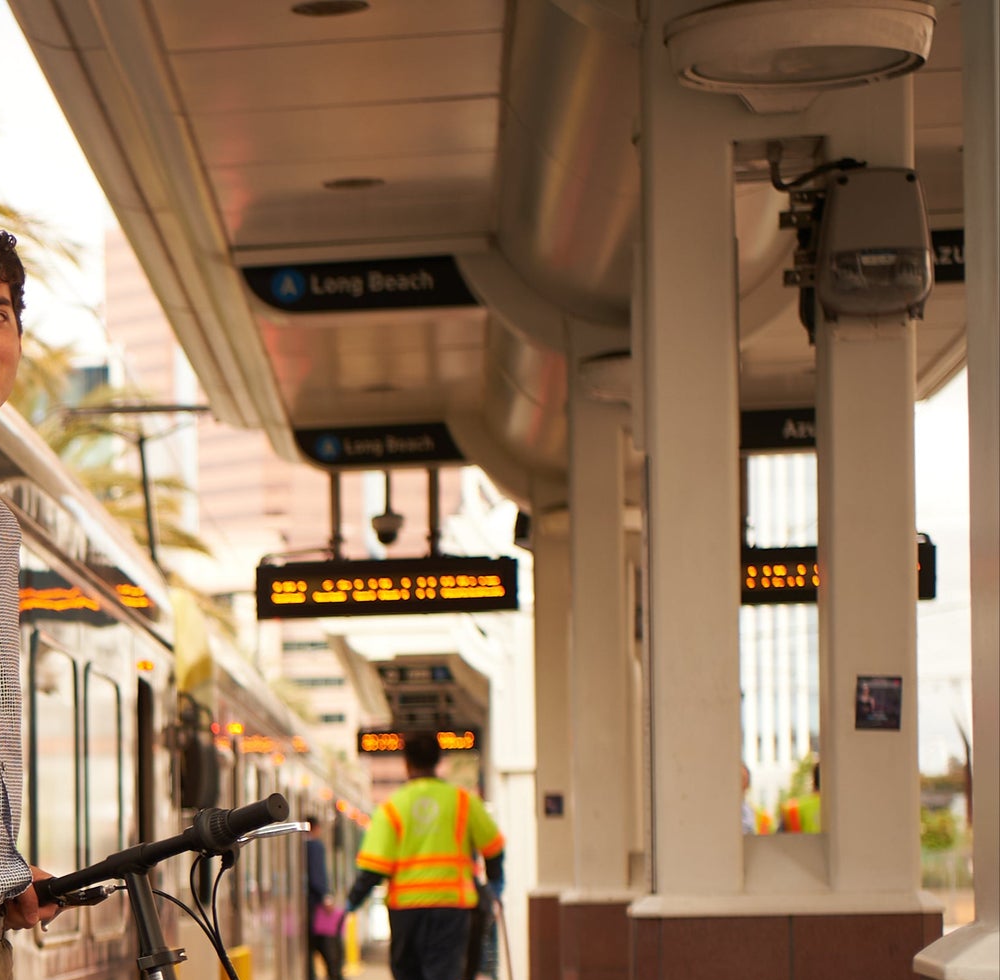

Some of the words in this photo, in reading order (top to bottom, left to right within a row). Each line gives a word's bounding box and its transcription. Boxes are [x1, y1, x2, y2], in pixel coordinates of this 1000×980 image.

[279, 274, 298, 296] A
[310, 273, 364, 298] Long
[368, 268, 434, 293] Beach
[343, 436, 384, 458] Long
[386, 433, 435, 455] Beach
